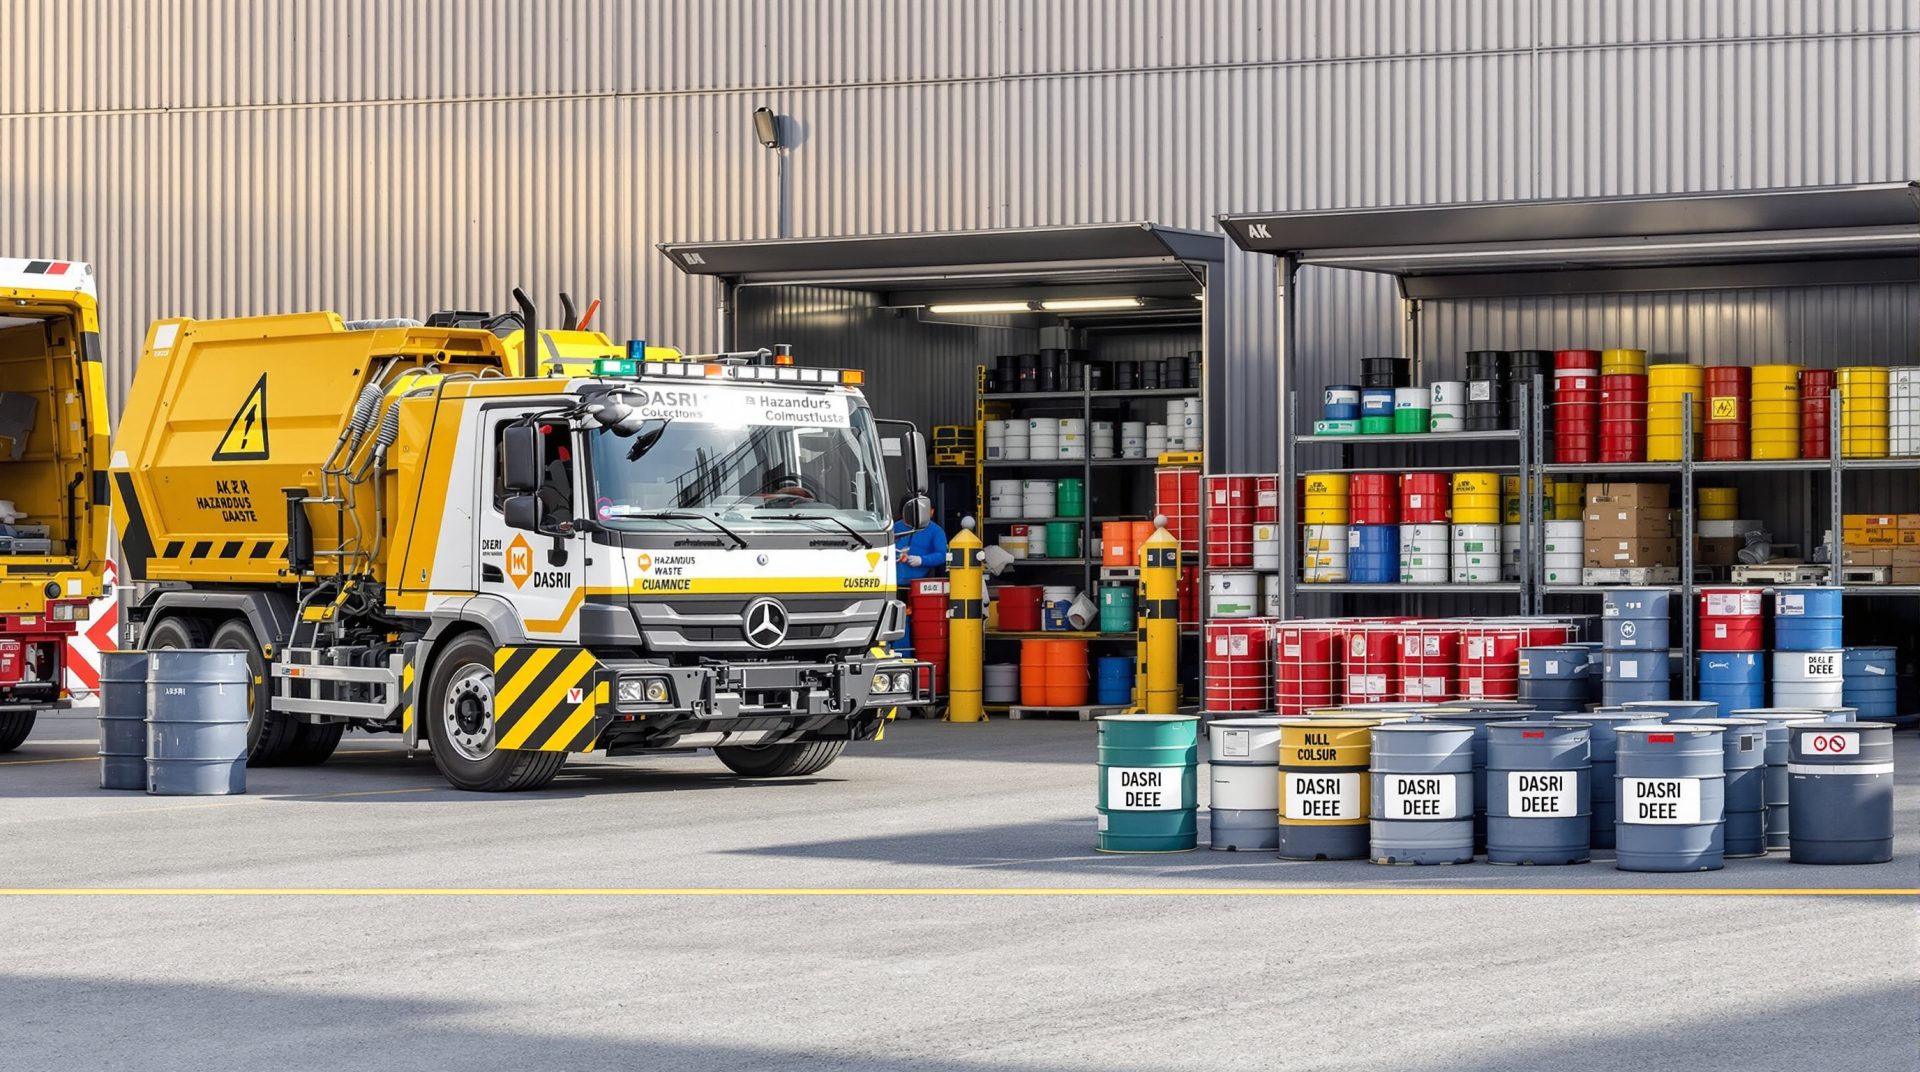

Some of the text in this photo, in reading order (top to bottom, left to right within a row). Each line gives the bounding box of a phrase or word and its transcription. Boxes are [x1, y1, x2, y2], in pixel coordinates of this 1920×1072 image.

[1248, 224, 1272, 238] AK
[654, 567, 683, 575] WASTE
[534, 572, 571, 588] DASRII
[1808, 664, 1834, 674] DEEE
[1297, 748, 1337, 761] COLSUR
[1121, 771, 1161, 787] DASRI
[1296, 778, 1341, 795] DASRI
[1398, 779, 1440, 795] DASRI
[1519, 775, 1563, 791] DASRI
[1637, 782, 1681, 798] DASRI
[1125, 791, 1161, 807] DEEE
[1403, 799, 1440, 815] DEEE
[1522, 796, 1559, 812] DEEE
[1303, 800, 1341, 816] DEEE
[1639, 803, 1677, 819] DEEE
